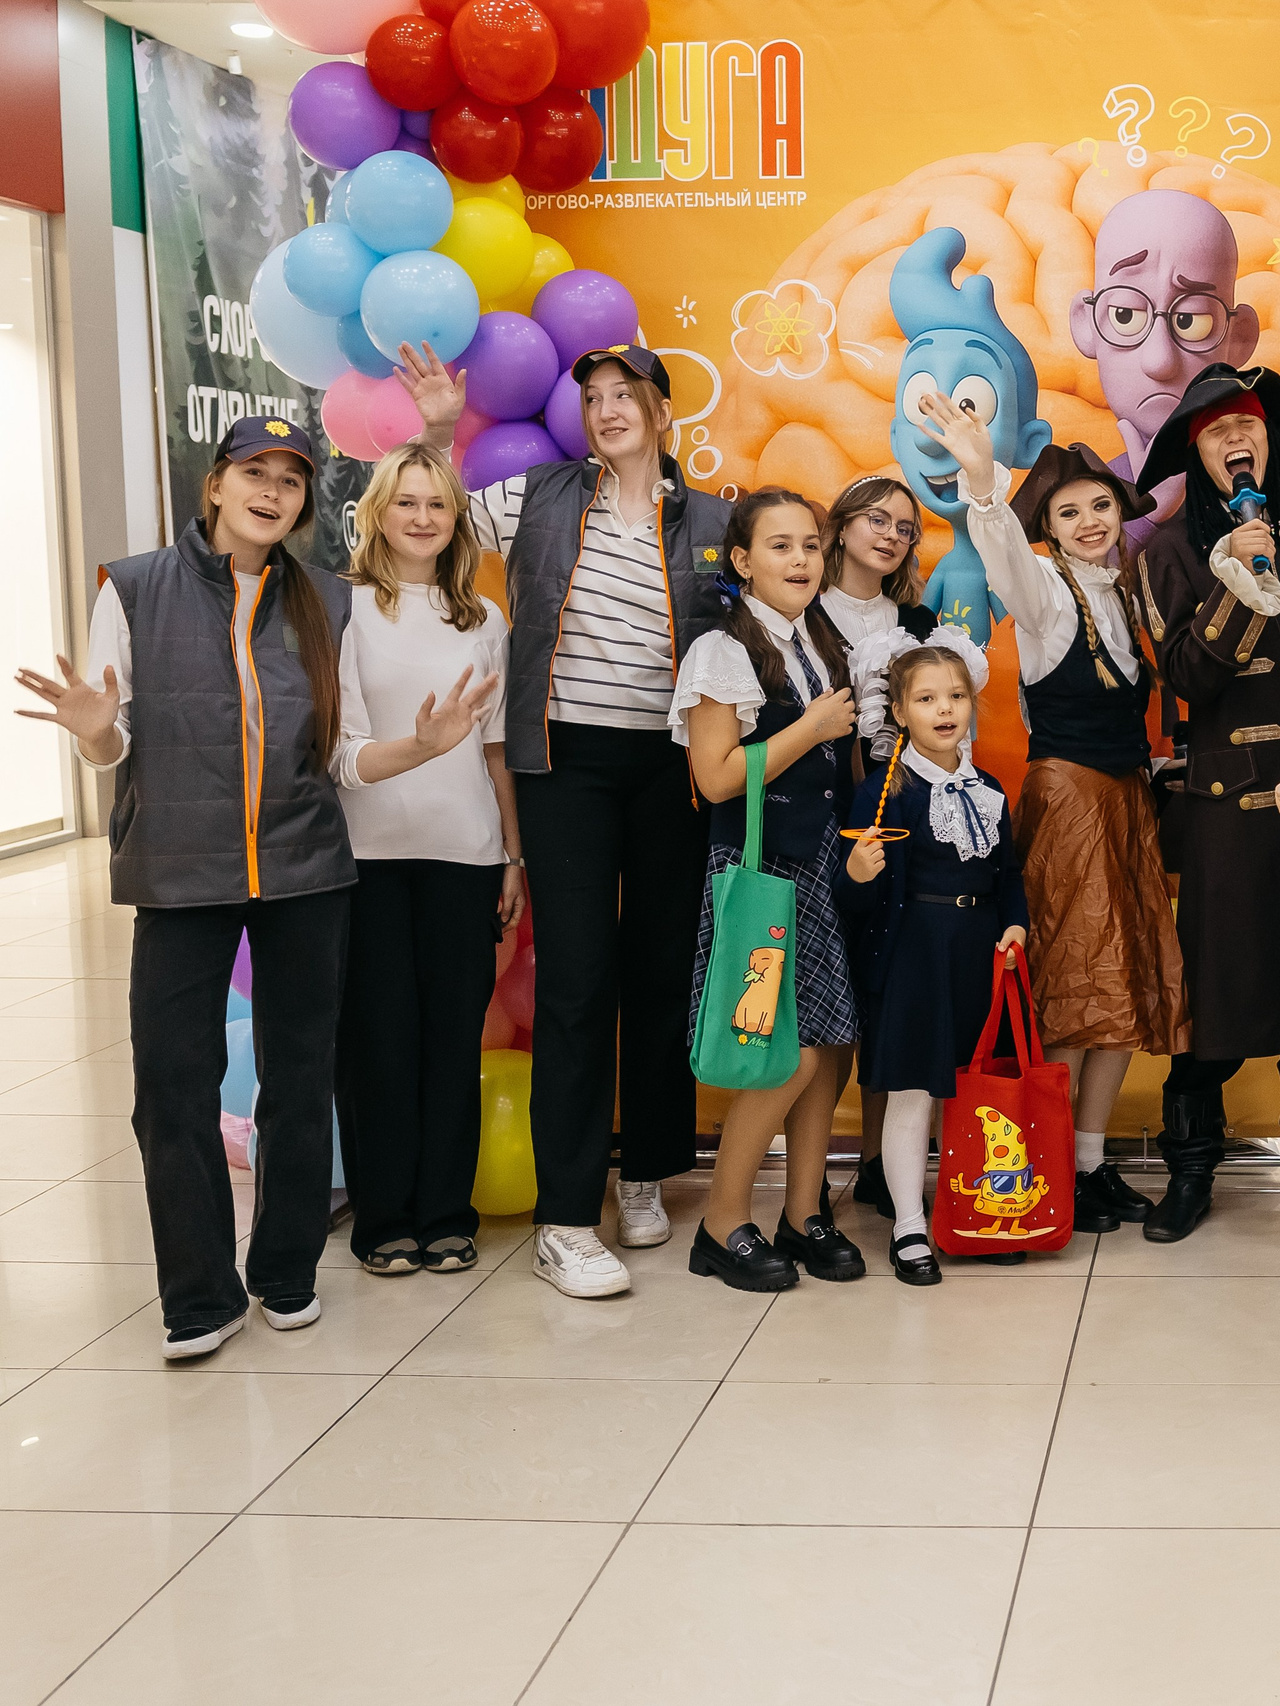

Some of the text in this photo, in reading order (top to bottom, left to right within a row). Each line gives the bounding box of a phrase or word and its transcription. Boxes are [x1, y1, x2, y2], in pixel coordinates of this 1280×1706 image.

[580, 38, 805, 182] ДУГА
[525, 189, 807, 211] ОРГОВО-РАЗВЛЕКАТЕЛЬНЫЙ ЦЕНТР
